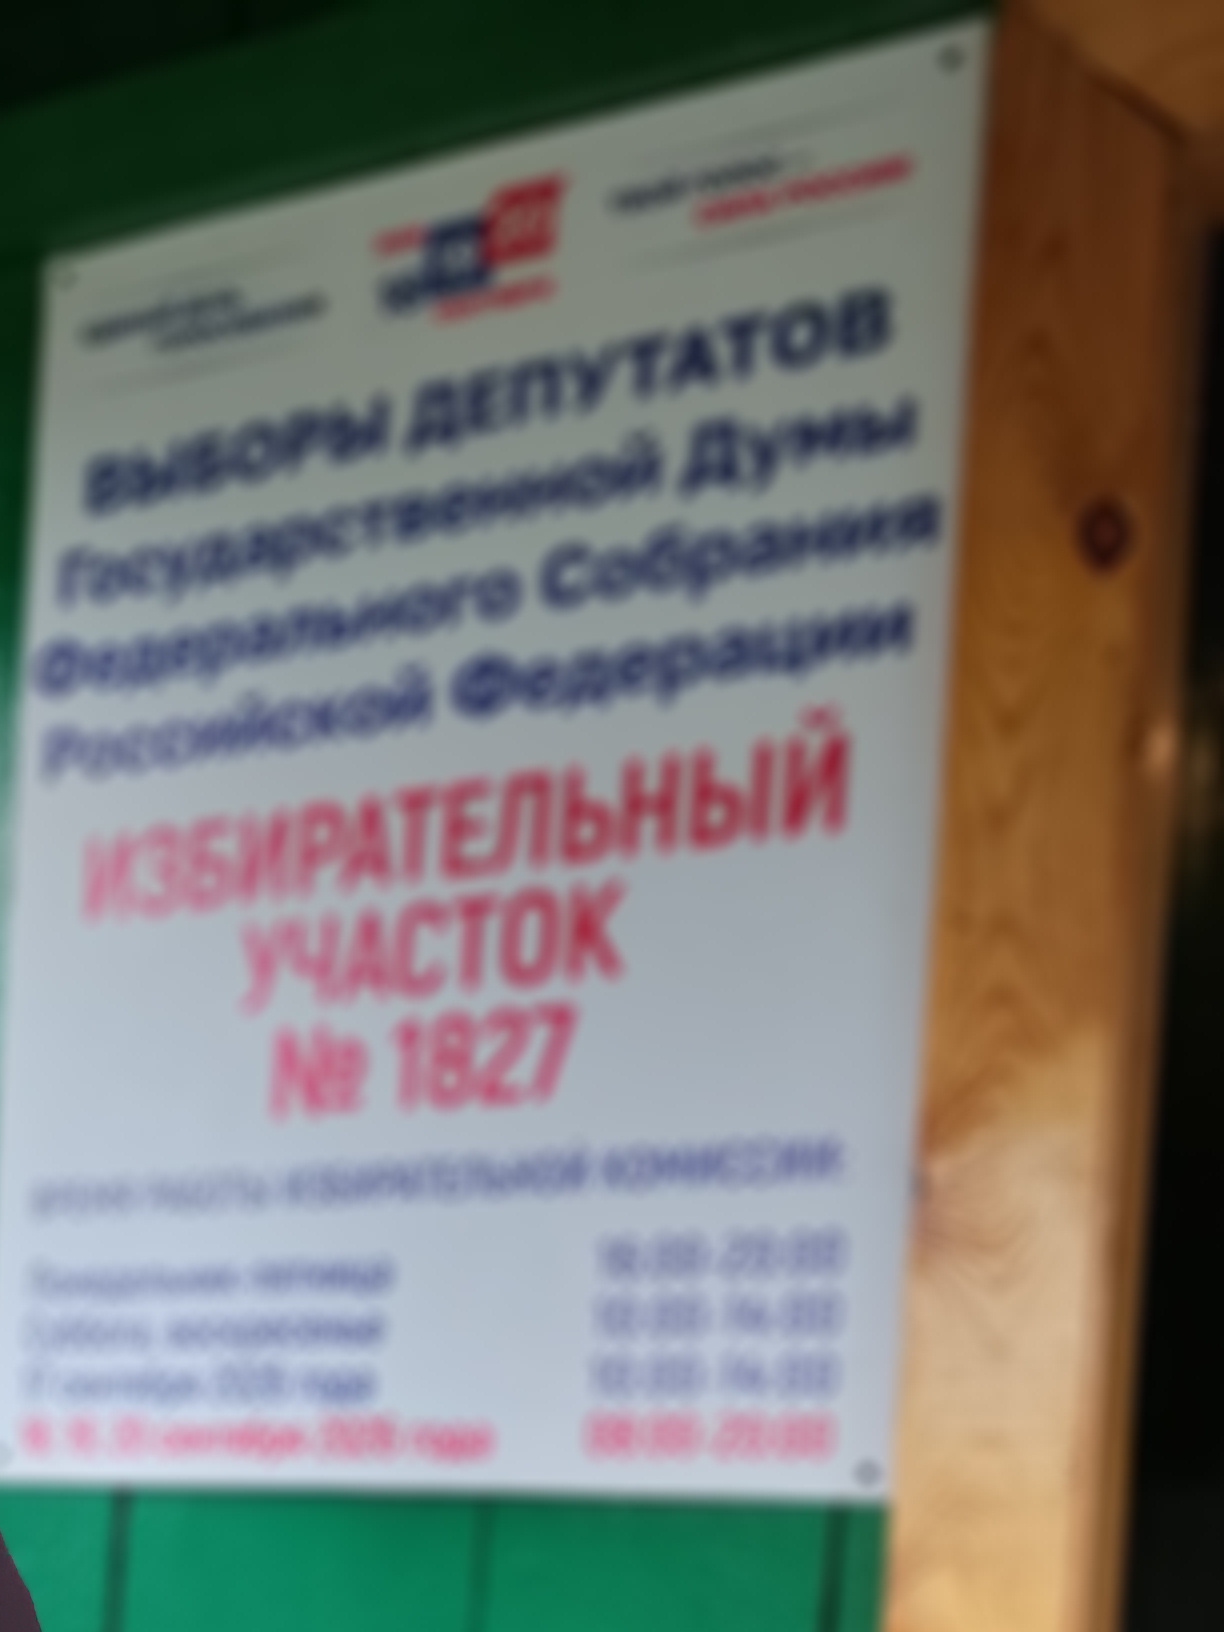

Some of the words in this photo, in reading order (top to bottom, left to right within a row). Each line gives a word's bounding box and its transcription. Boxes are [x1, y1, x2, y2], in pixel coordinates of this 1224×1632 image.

[58, 428, 662, 608] Государственной
[680, 396, 917, 498] Думы
[84, 393, 391, 518] ВЫБОРЫ
[406, 285, 893, 456] ДЕПУТАТОВ
[34, 568, 520, 697] Федерального
[540, 493, 941, 602] Собрания
[42, 662, 436, 782] Российской
[450, 582, 914, 720] Федерации
[81, 705, 853, 924] ИЗБИРАТЕЛЬНЫЙ
[242, 880, 624, 1012] УЧАСТОК
[270, 1023, 368, 1119] №
[392, 1003, 579, 1110] 1827
